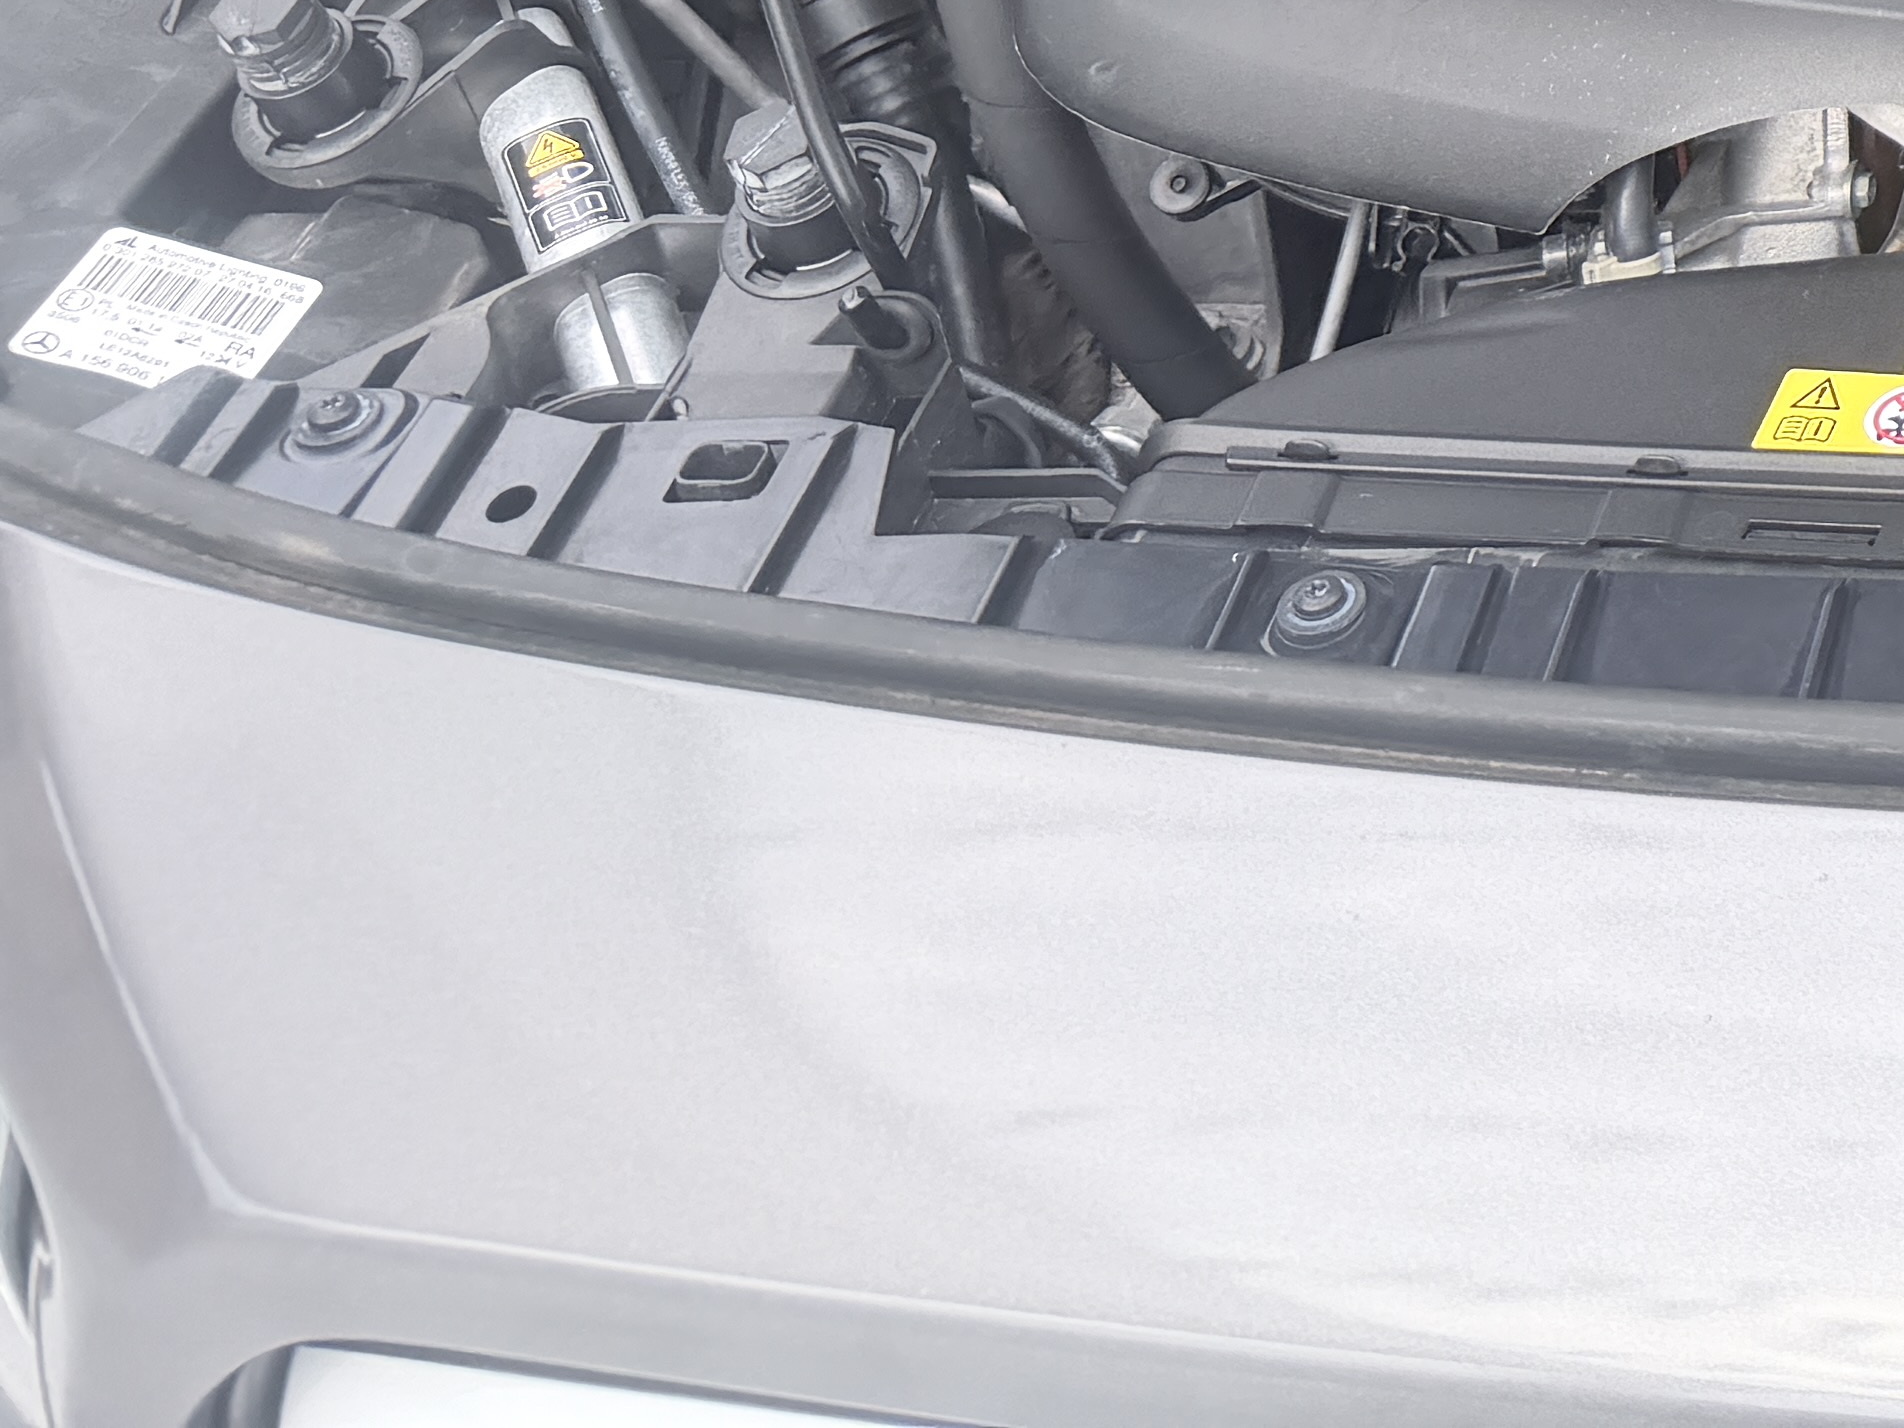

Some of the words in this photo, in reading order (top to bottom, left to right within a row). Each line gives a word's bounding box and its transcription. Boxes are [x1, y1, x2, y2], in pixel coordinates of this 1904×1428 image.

[100, 243, 112, 251] 0
[235, 279, 255, 289] 04
[145, 243, 219, 269] Automotive
[215, 263, 270, 284] Lighting
[58, 348, 76, 359] A
[78, 353, 115, 368] 156
[222, 341, 260, 359] RA
[233, 360, 247, 369] V
